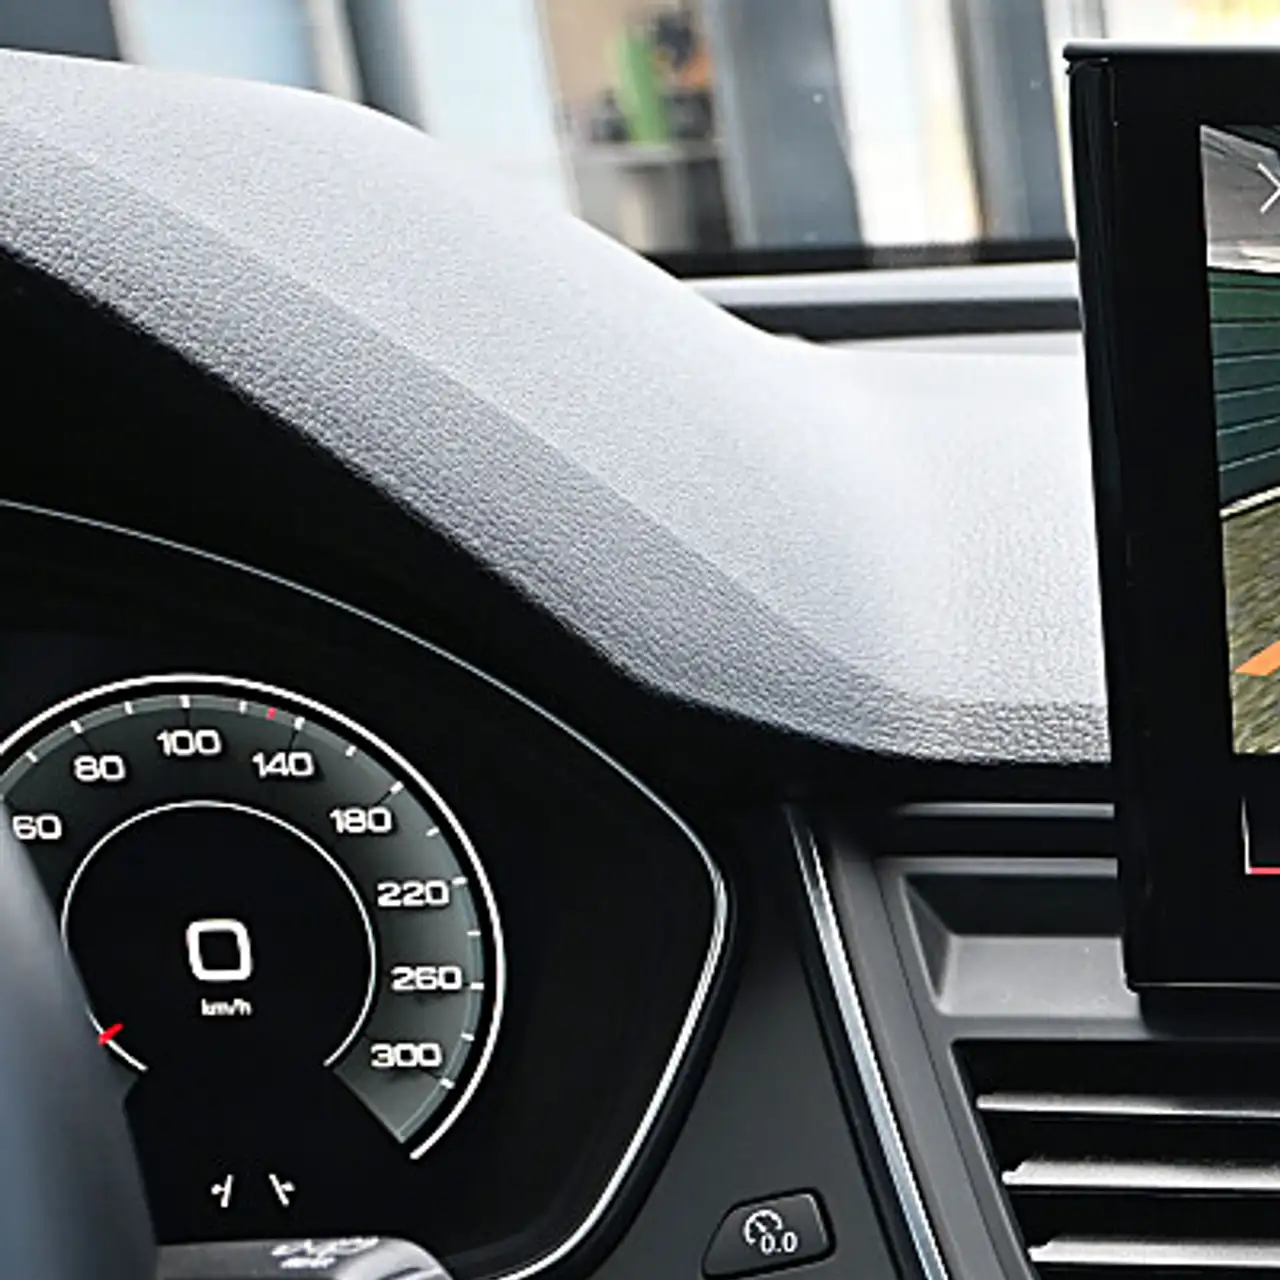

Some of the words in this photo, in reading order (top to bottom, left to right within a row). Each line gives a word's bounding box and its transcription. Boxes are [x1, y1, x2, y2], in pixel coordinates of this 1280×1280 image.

[156, 729, 222, 757] 100
[74, 755, 126, 783] 80
[252, 751, 315, 779] 140
[12, 813, 63, 841] 60
[329, 806, 392, 834] 180
[376, 879, 449, 907] 220
[186, 918, 252, 982] 0
[391, 965, 463, 991] 260
[201, 998, 252, 1017] km/h
[371, 1042, 442, 1069] 300
[760, 1231, 798, 1255] 0.0
